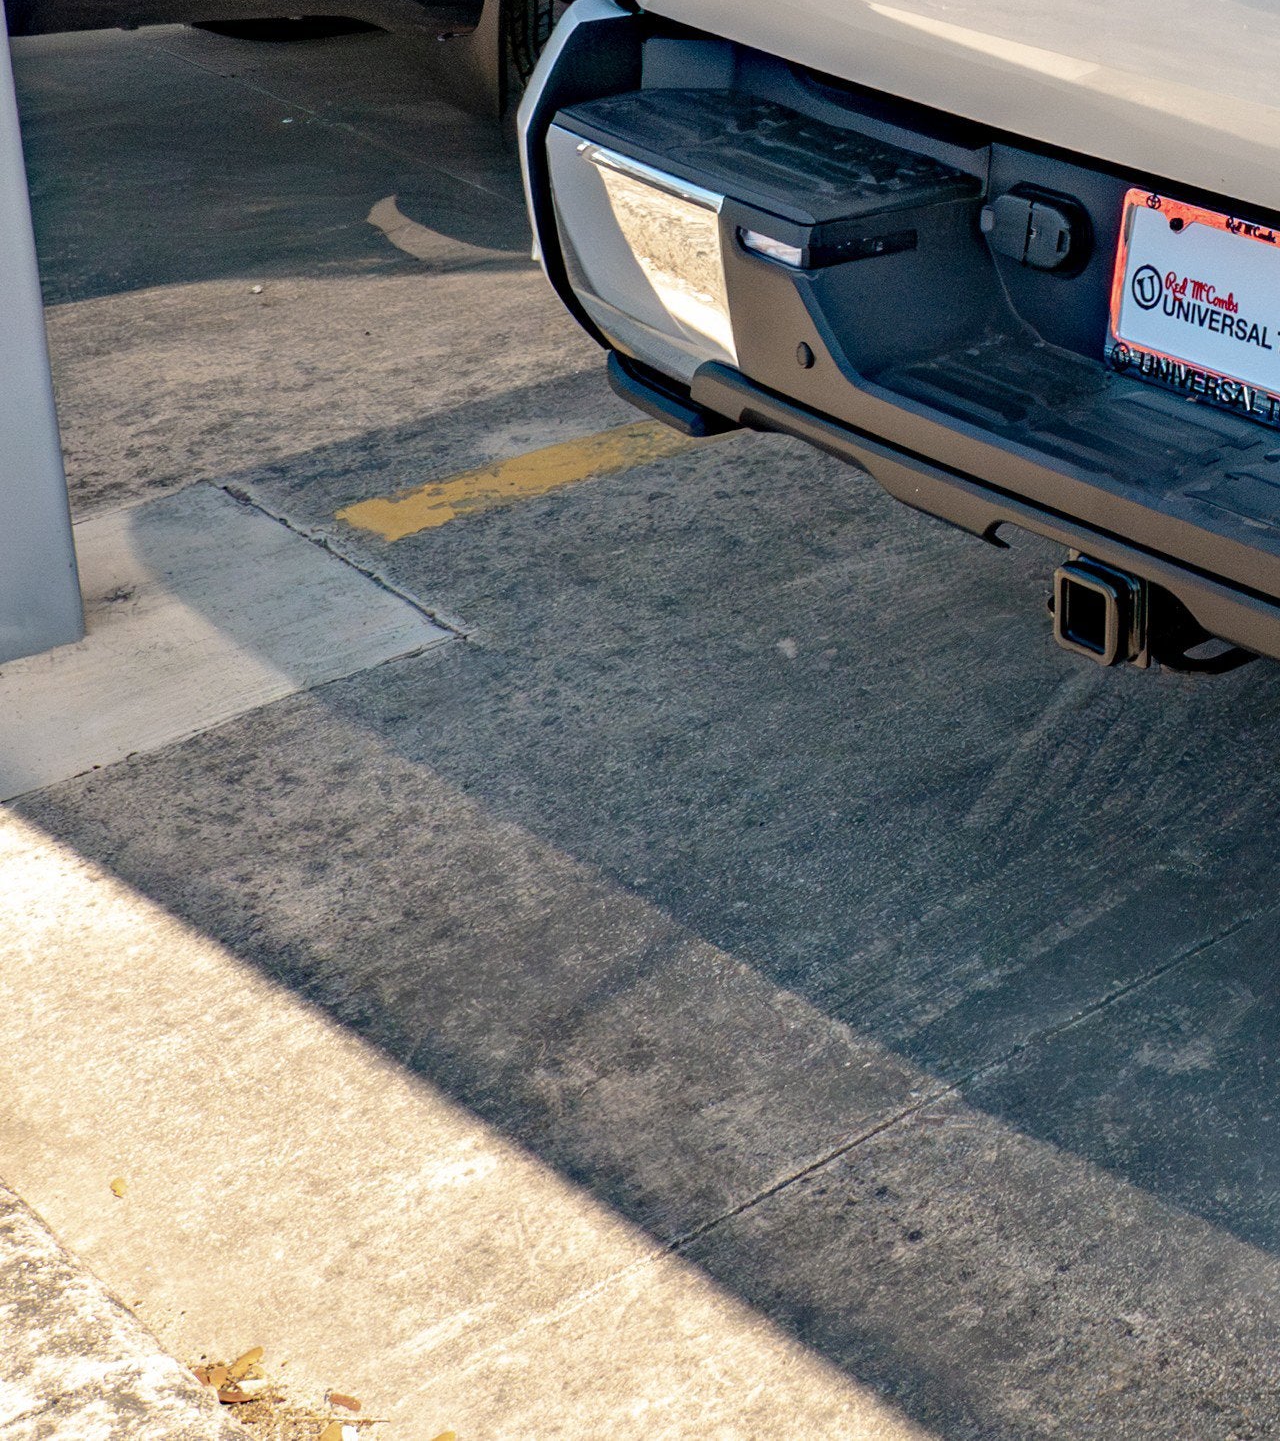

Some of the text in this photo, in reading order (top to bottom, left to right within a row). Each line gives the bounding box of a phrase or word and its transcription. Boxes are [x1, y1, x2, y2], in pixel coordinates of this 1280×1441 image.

[1165, 271, 1239, 314] Red McCombs
[1162, 294, 1273, 351] UNIVERSAL
[1138, 351, 1263, 414] UNIVERSAL
